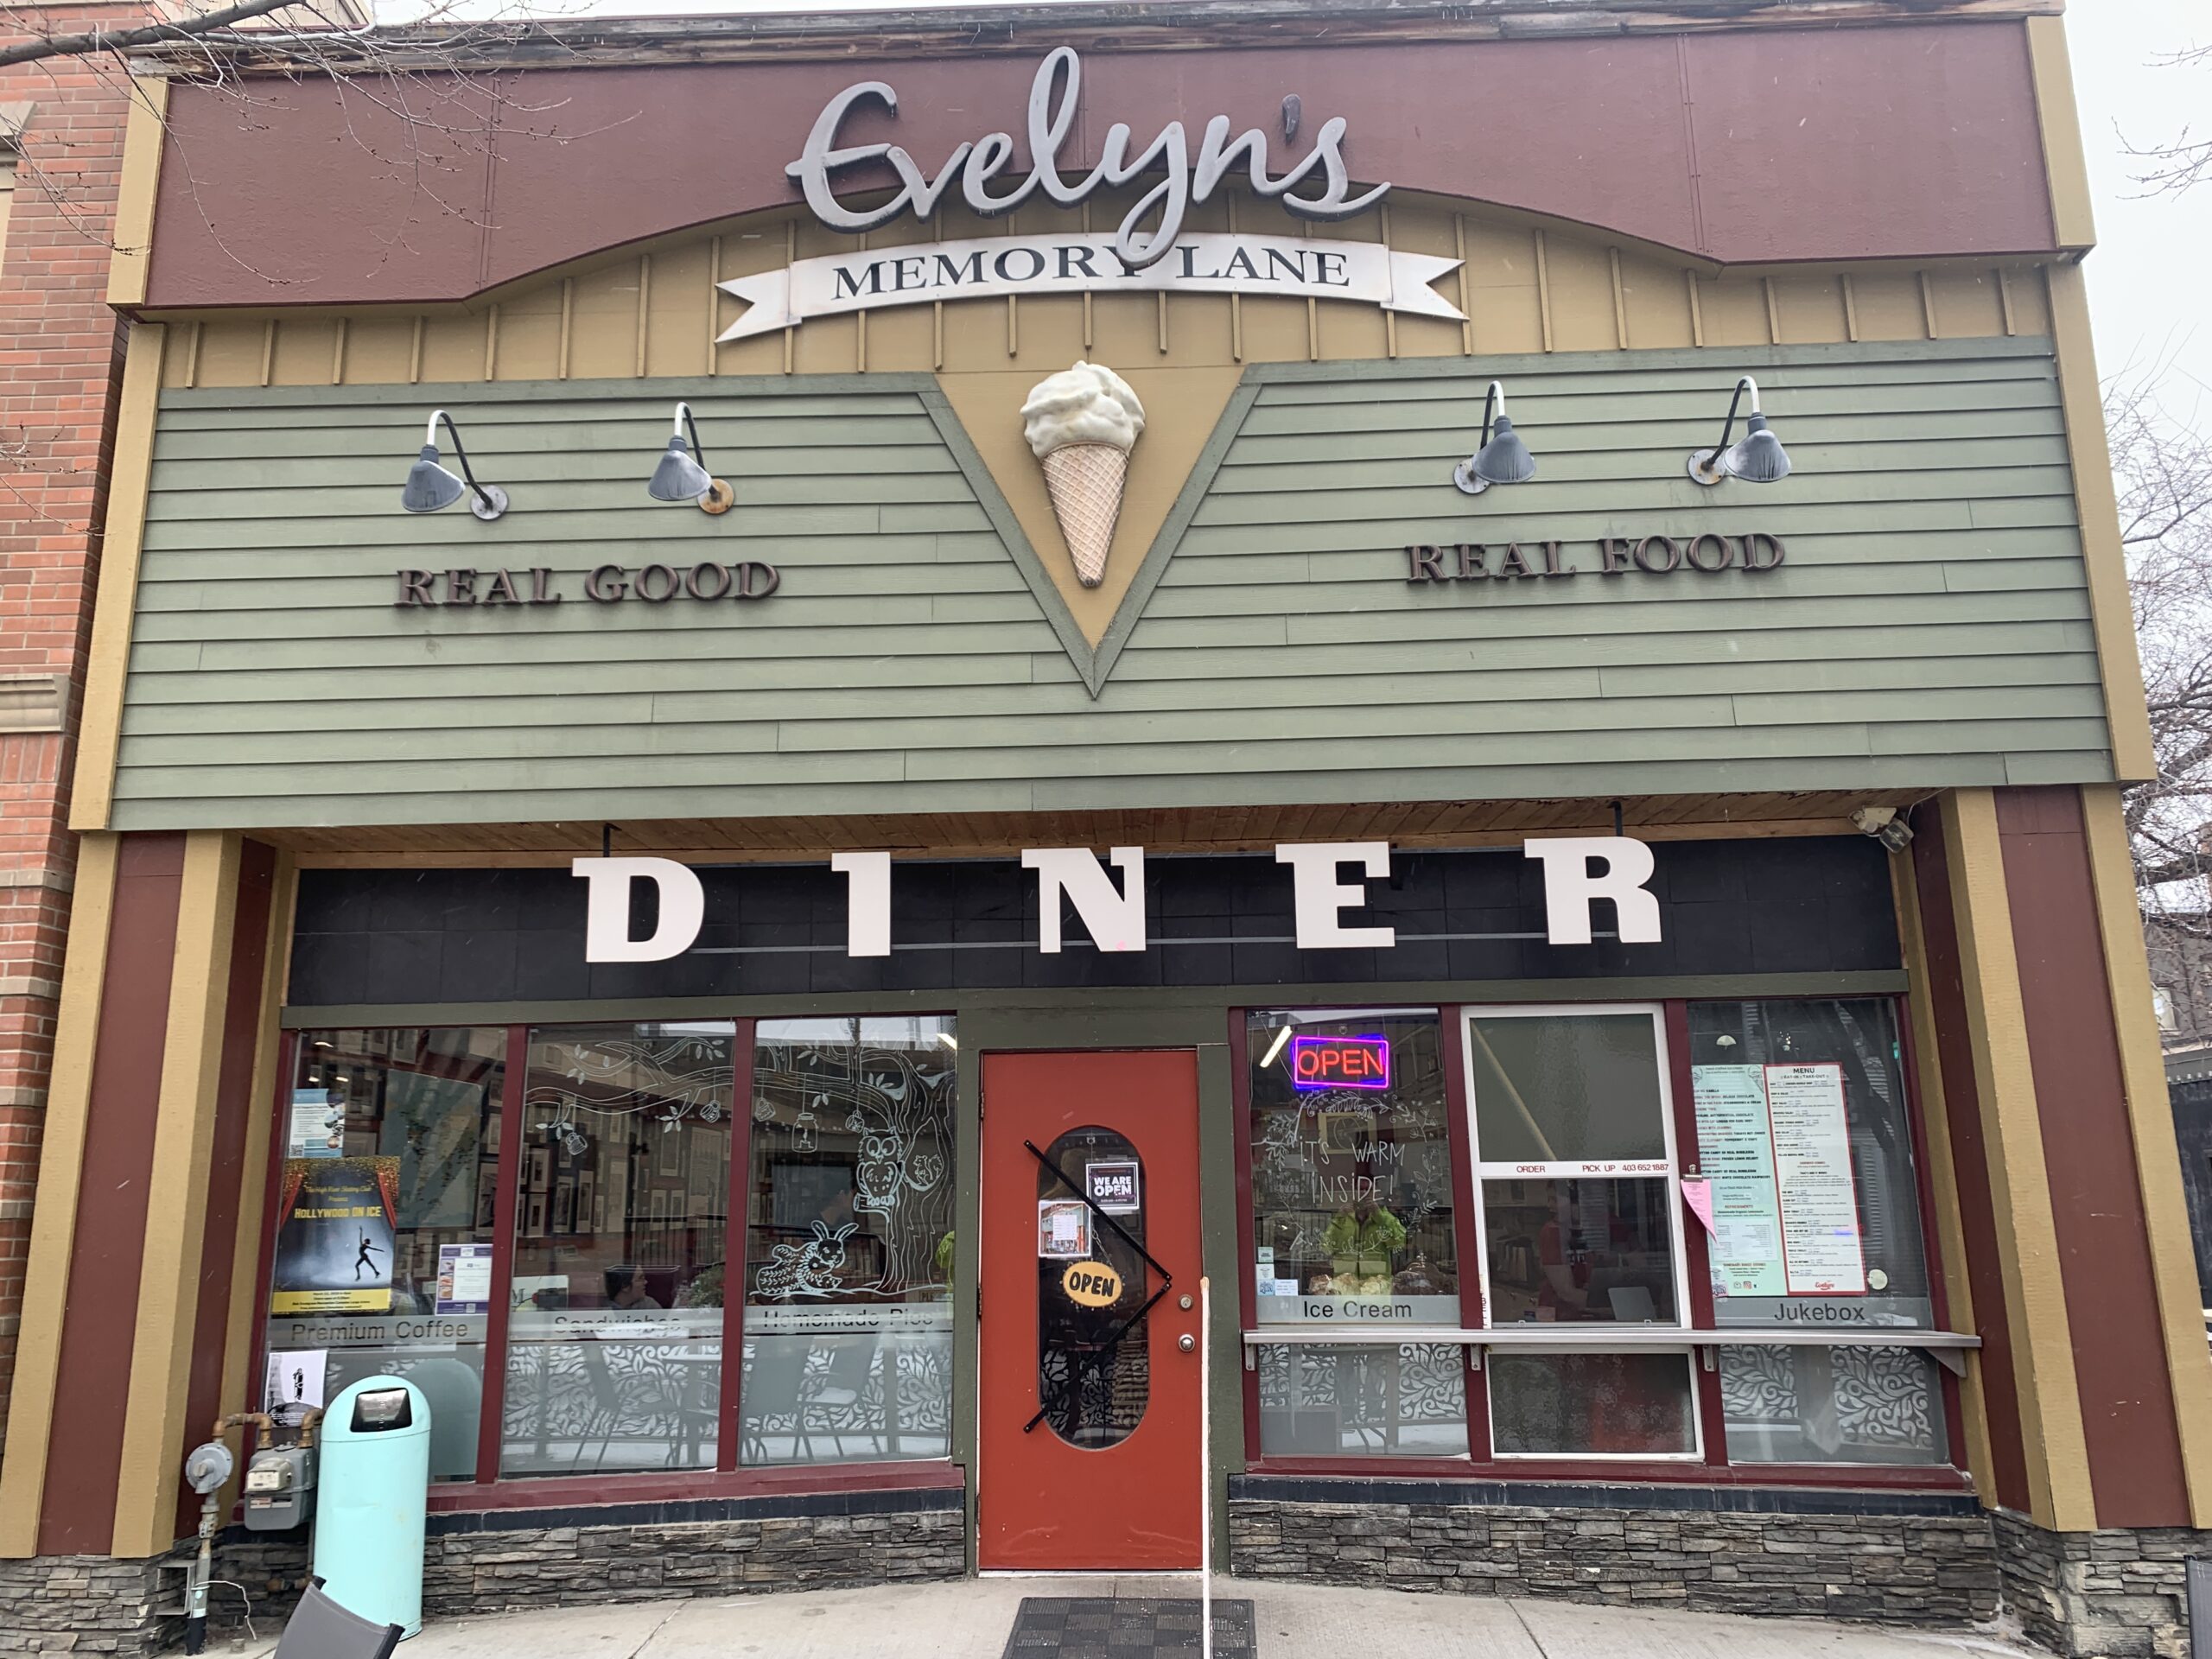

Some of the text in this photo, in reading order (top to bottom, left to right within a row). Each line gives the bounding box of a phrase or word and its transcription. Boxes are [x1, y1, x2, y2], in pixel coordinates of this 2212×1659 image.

[785, 45, 1392, 266] Evelyn's
[1176, 246, 1351, 286] LANE
[1405, 532, 1786, 583] REAL FOOD
[394, 562, 781, 608] REAL GOOD
[571, 836, 1662, 963] DINER
[1297, 1048, 1385, 1077] OPEN
[1351, 1141, 1405, 1166] WARM
[1094, 1176, 1132, 1185] WE ARE
[1516, 1165, 1546, 1173] ORDER
[1094, 1185, 1132, 1197] OPEN
[1312, 1171, 1393, 1204] INSIDE!
[294, 1206, 382, 1218] HOLLYWOOD ON ICE
[1069, 1271, 1115, 1298] OPEN
[1303, 1300, 1412, 1319] Ice Cream
[1774, 1303, 1866, 1322] Jukebox
[291, 1320, 468, 1341] Premium Coffee
